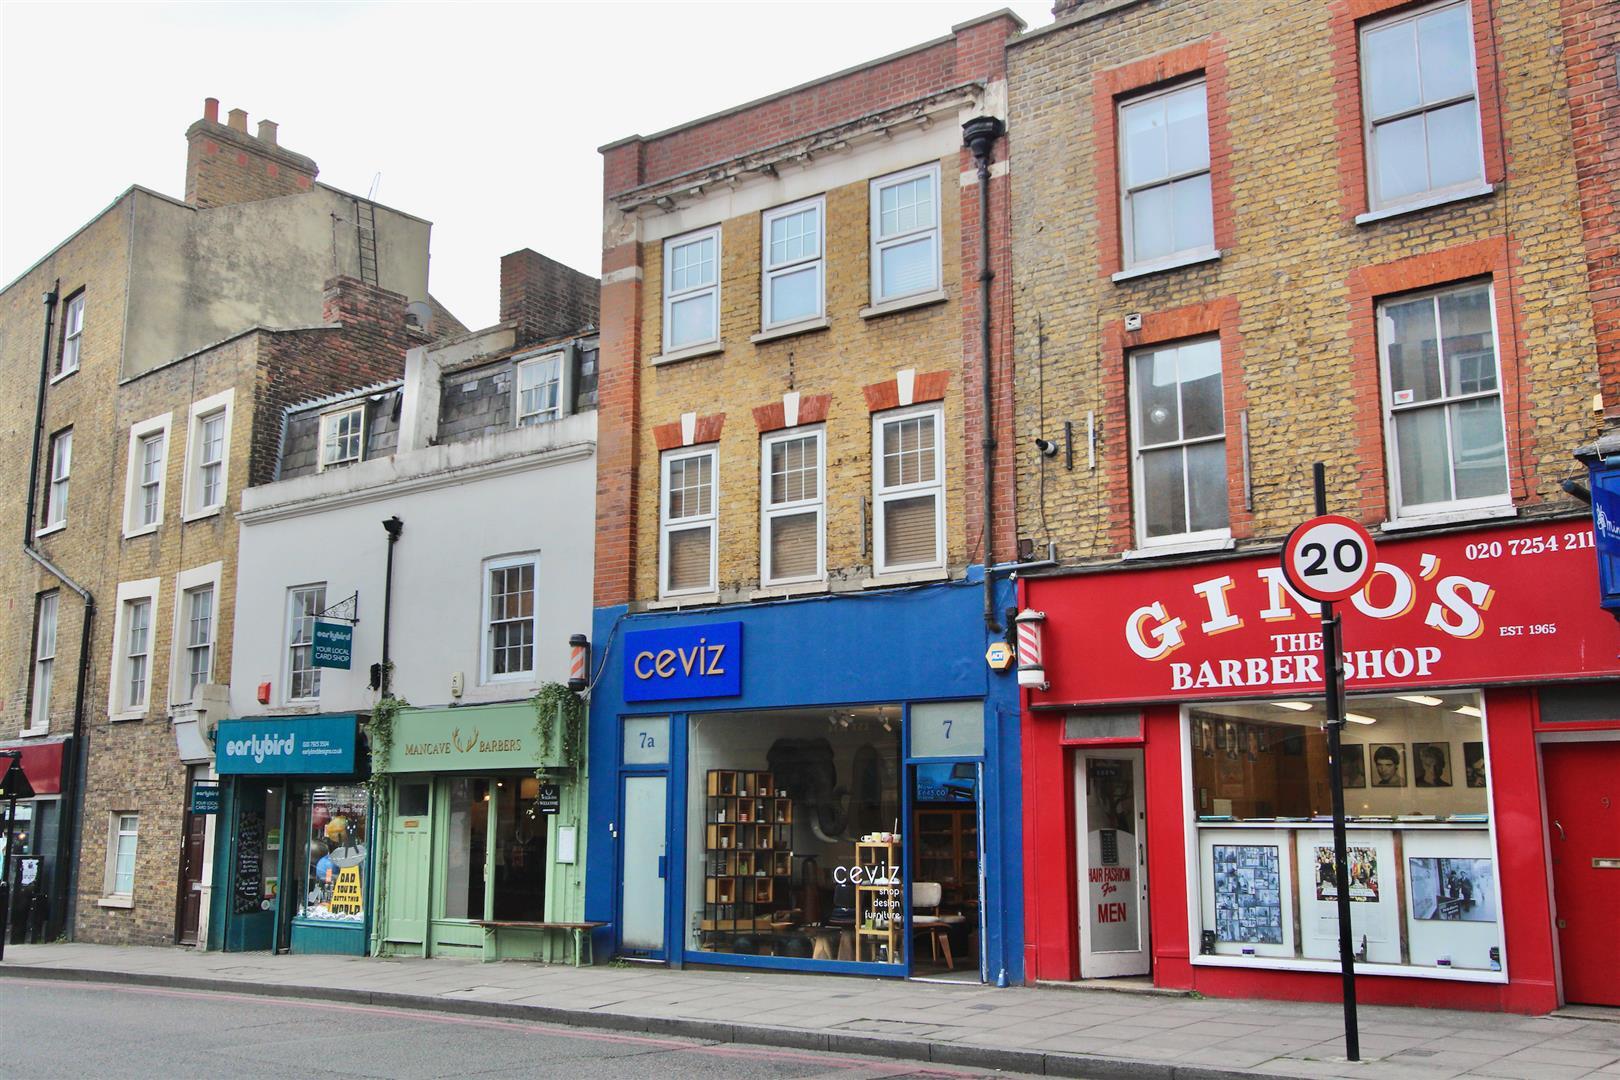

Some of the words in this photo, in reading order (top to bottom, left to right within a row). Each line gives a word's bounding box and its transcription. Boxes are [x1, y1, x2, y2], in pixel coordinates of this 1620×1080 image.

[1465, 541, 1502, 560] 020
[1508, 535, 1558, 556] 7254
[1301, 539, 1363, 576] 20
[316, 631, 351, 641] earlybird
[1499, 625, 1524, 637] EST
[1529, 623, 1557, 636] 1965
[1270, 632, 1324, 654] THE
[316, 646, 331, 654] YOUR
[332, 648, 349, 656] LOCAL
[634, 637, 725, 679] ceviz
[1170, 654, 1323, 691] BARBER
[1342, 646, 1442, 681] SHOP
[942, 720, 952, 739] 7
[226, 733, 295, 763] earlybird
[479, 739, 522, 753] BARBERS
[639, 732, 655, 749] 7a
[405, 742, 451, 756] MANCAVE
[340, 873, 356, 883] DAD
[1088, 867, 1103, 883] HAIR
[1104, 867, 1131, 882] FASHION
[879, 888, 900, 898] shop
[331, 904, 361, 915] WORLD
[873, 899, 900, 910] design
[864, 910, 901, 920] furniture
[1098, 902, 1127, 923] MEN
